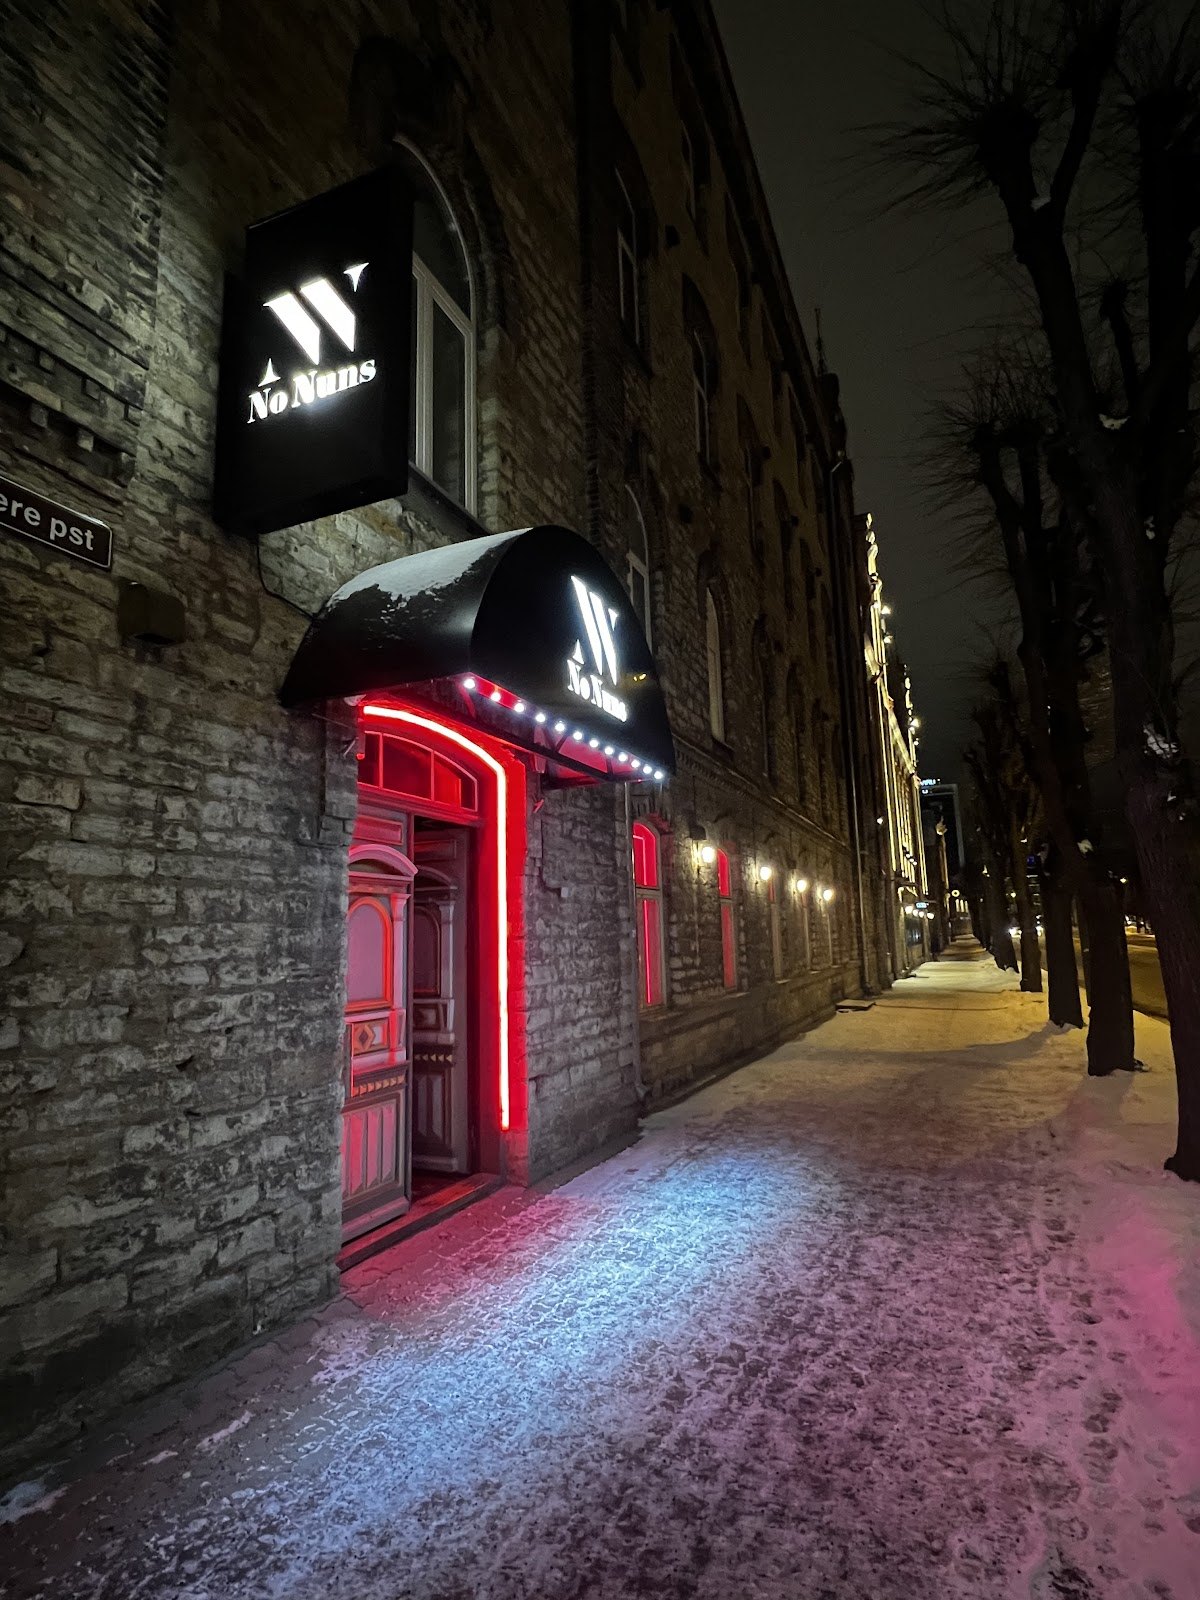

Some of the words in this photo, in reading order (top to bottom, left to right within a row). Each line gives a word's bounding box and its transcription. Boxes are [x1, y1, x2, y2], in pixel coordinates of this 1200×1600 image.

[247, 387, 289, 424] No
[291, 359, 377, 409] Nuns
[49, 517, 94, 551] pst
[566, 659, 591, 700] No
